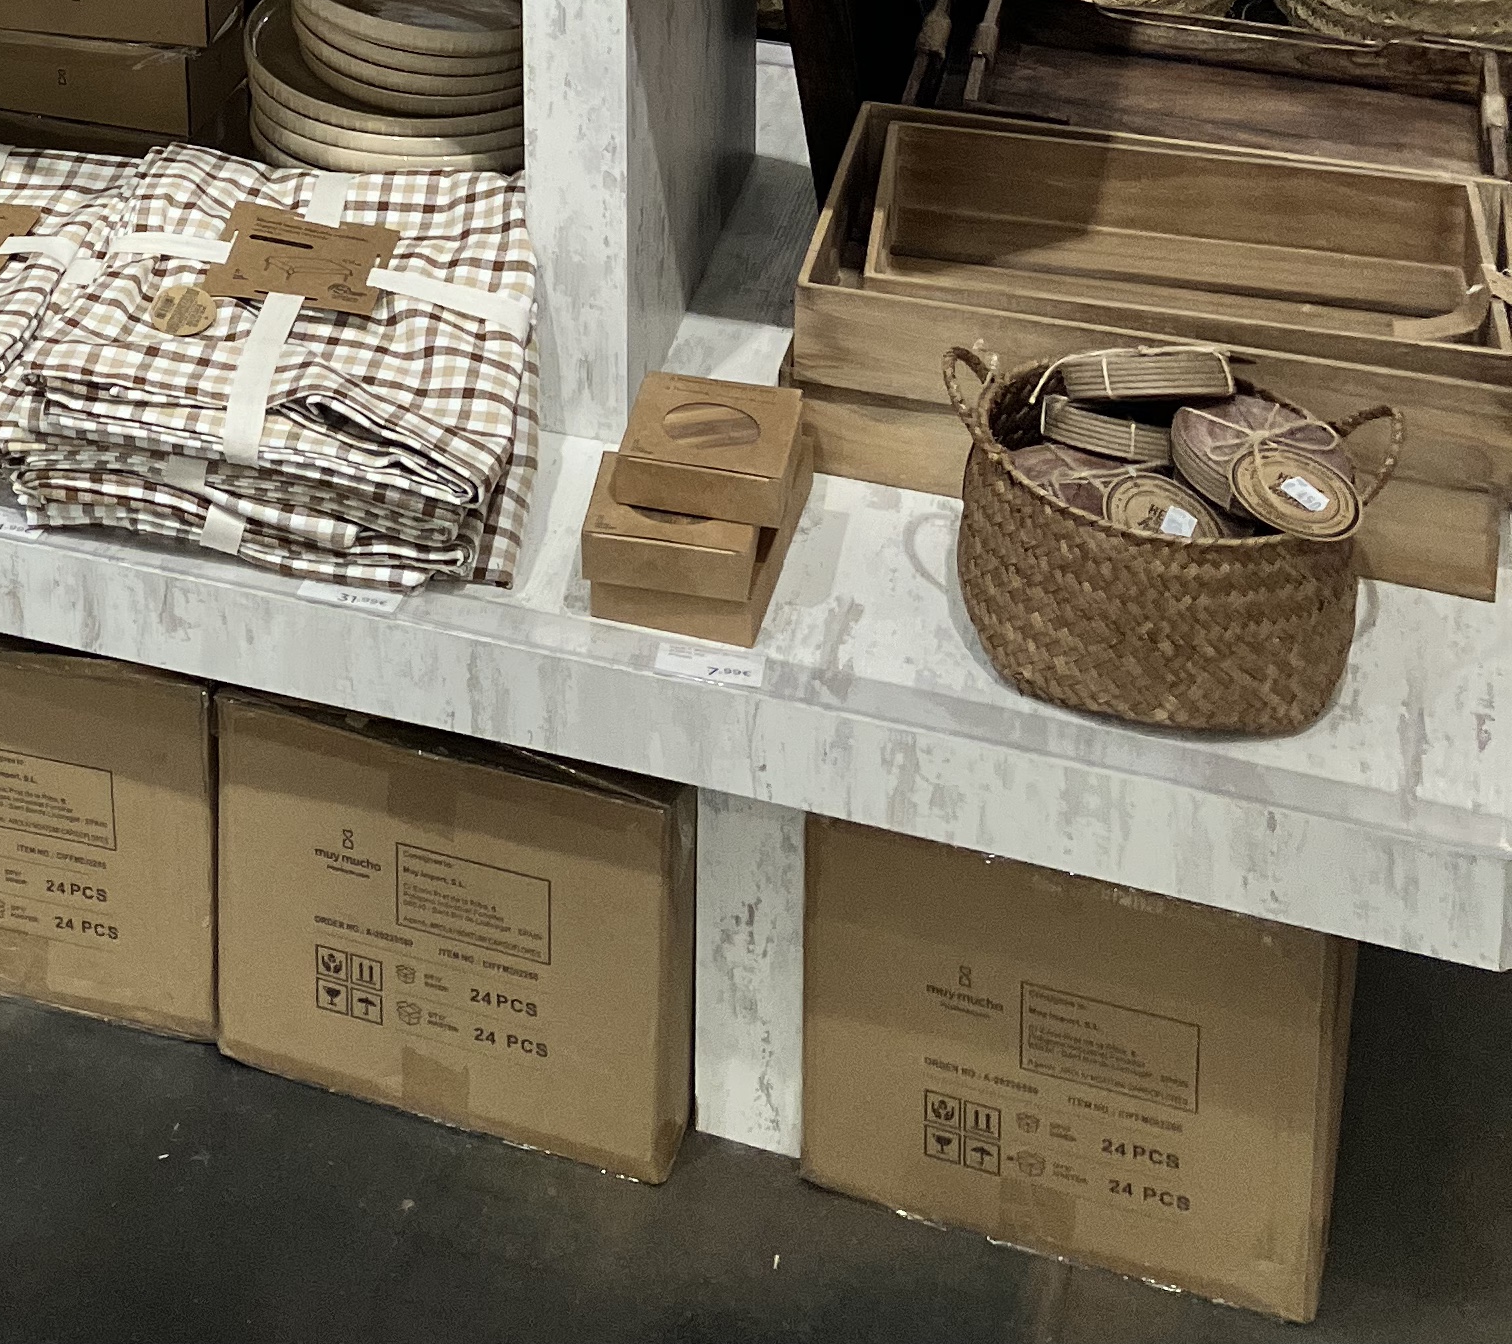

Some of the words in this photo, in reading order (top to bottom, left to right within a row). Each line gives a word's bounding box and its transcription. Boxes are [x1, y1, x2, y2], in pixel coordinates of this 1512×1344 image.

[314, 848, 339, 863] muy
[341, 853, 382, 872] mucho
[54, 916, 74, 931] 24
[81, 920, 119, 940] PCS
[473, 1027, 496, 1046] 24
[506, 1034, 549, 1058] PCS
[1108, 1178, 1134, 1197] 24
[1142, 1186, 1191, 1212] PCS
